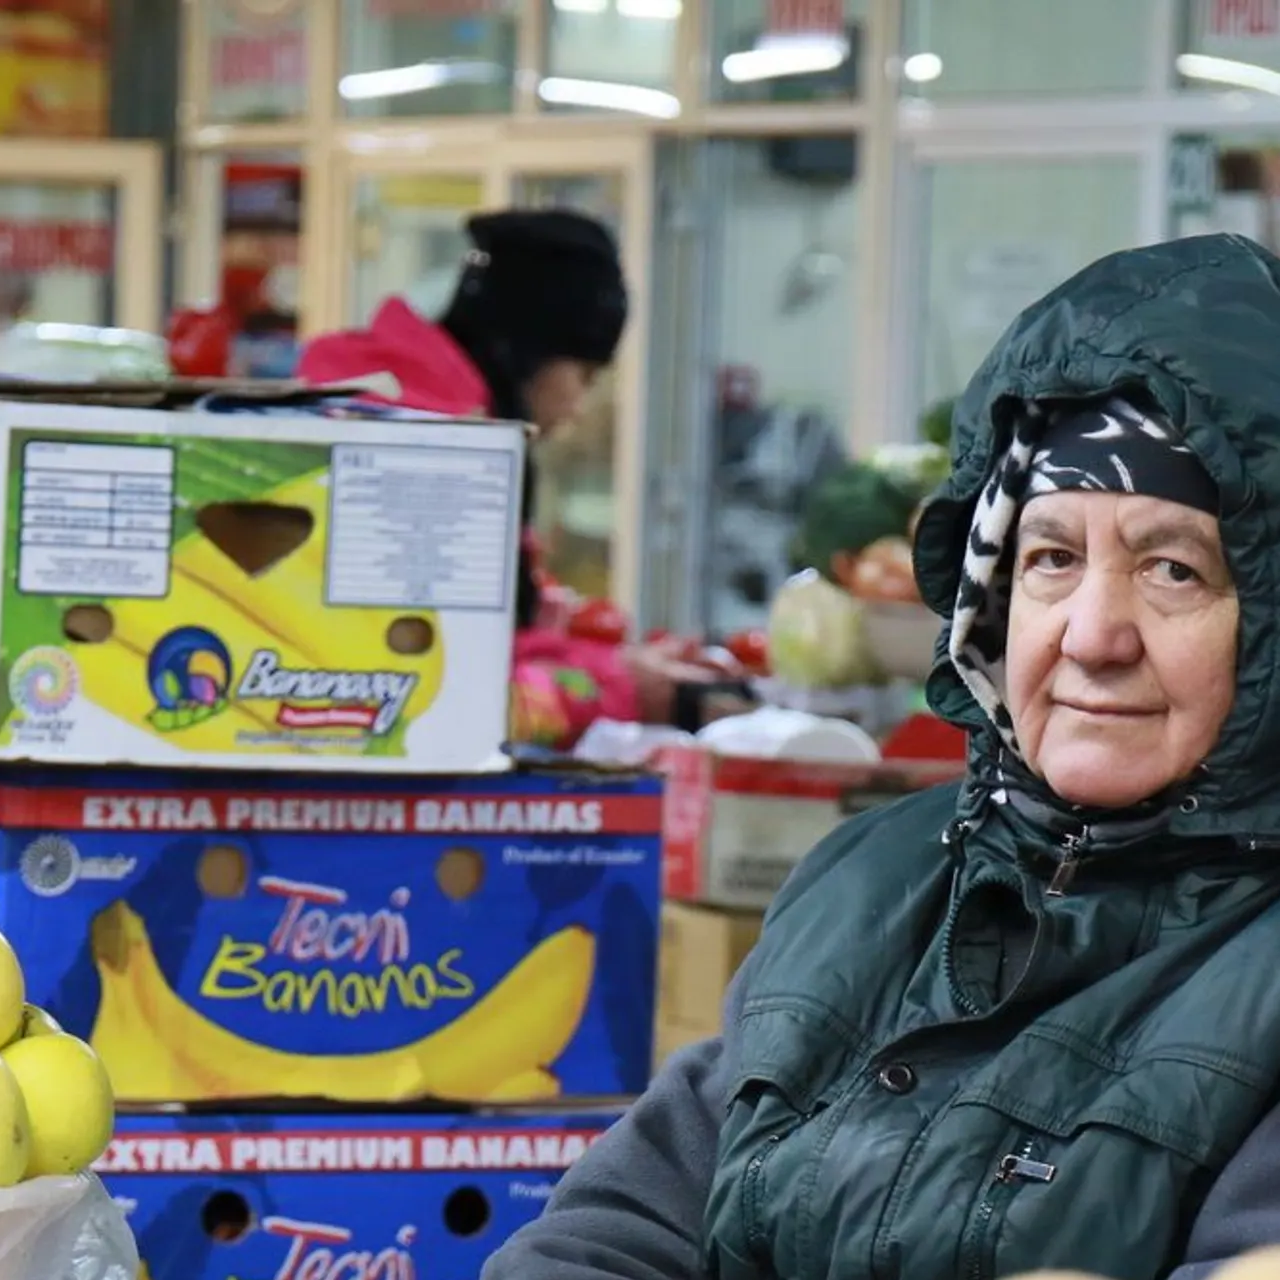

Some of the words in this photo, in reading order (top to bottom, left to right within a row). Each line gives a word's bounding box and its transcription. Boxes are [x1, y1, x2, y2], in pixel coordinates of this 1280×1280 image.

[82, 797, 217, 829] EXTRA
[226, 799, 406, 831] PREMIUM
[414, 800, 604, 833] BANANAS
[257, 876, 411, 964] Tecni
[200, 934, 475, 1018] Bananas
[228, 1136, 413, 1170] PREMIUM
[421, 1134, 603, 1170] BANANA
